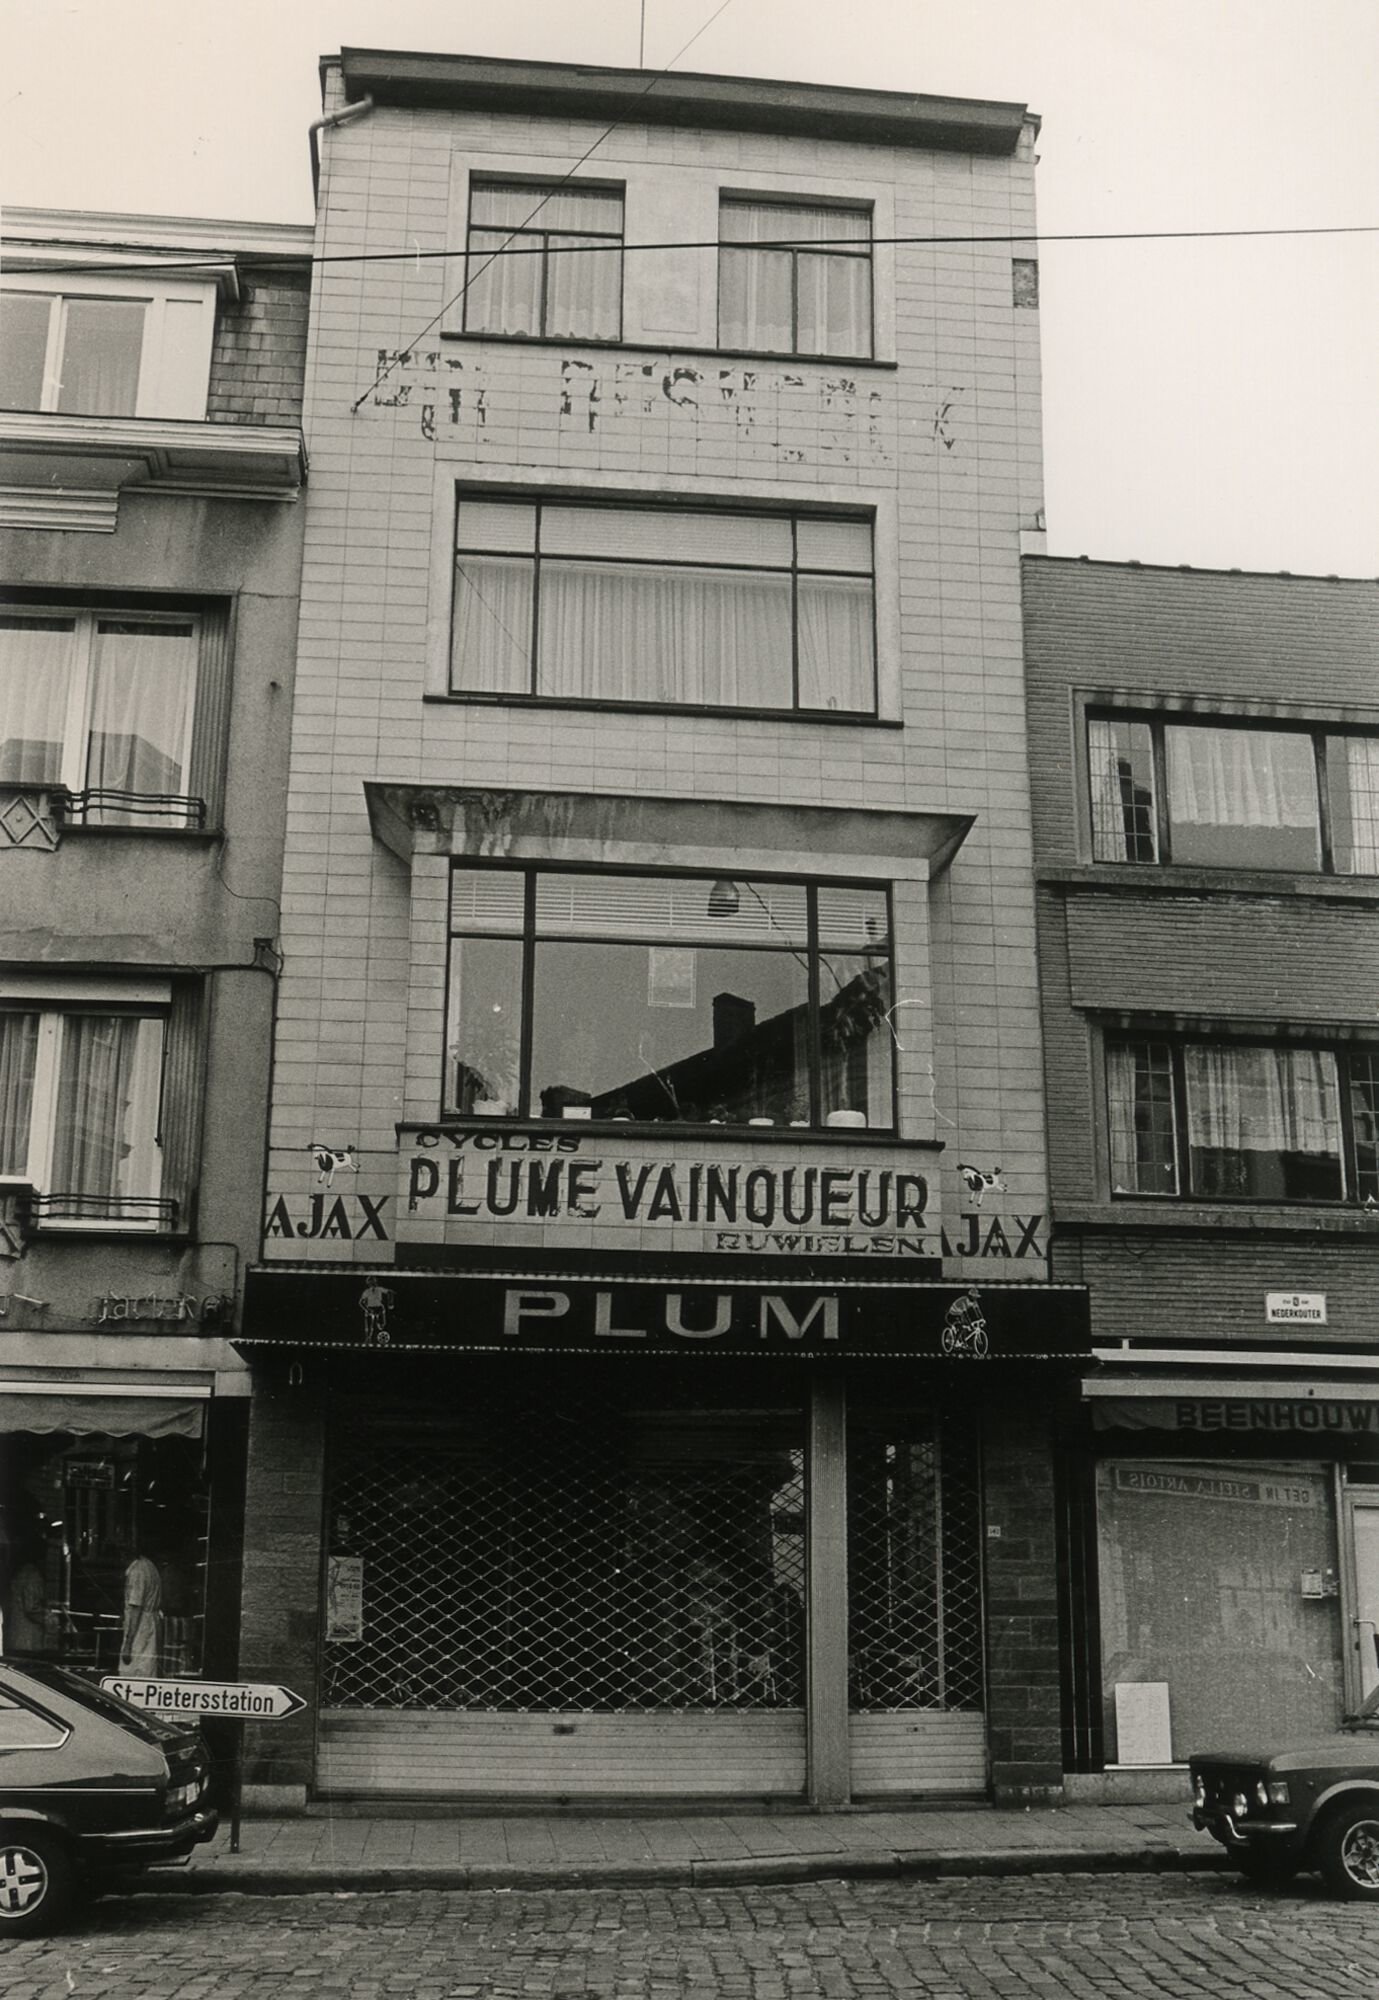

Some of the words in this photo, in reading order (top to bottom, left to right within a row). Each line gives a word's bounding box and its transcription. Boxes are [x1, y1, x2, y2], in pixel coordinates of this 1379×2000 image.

[415, 1132, 581, 1153] CYCLES
[409, 1155, 602, 1218] PLUME
[616, 1161, 928, 1229] VAINQUEUR
[263, 1193, 389, 1241] AJAX
[503, 1289, 839, 1340] PLUM
[1176, 1403, 1379, 1429] BEENHOUW
[112, 1682, 274, 1713] St-Pietersstation
